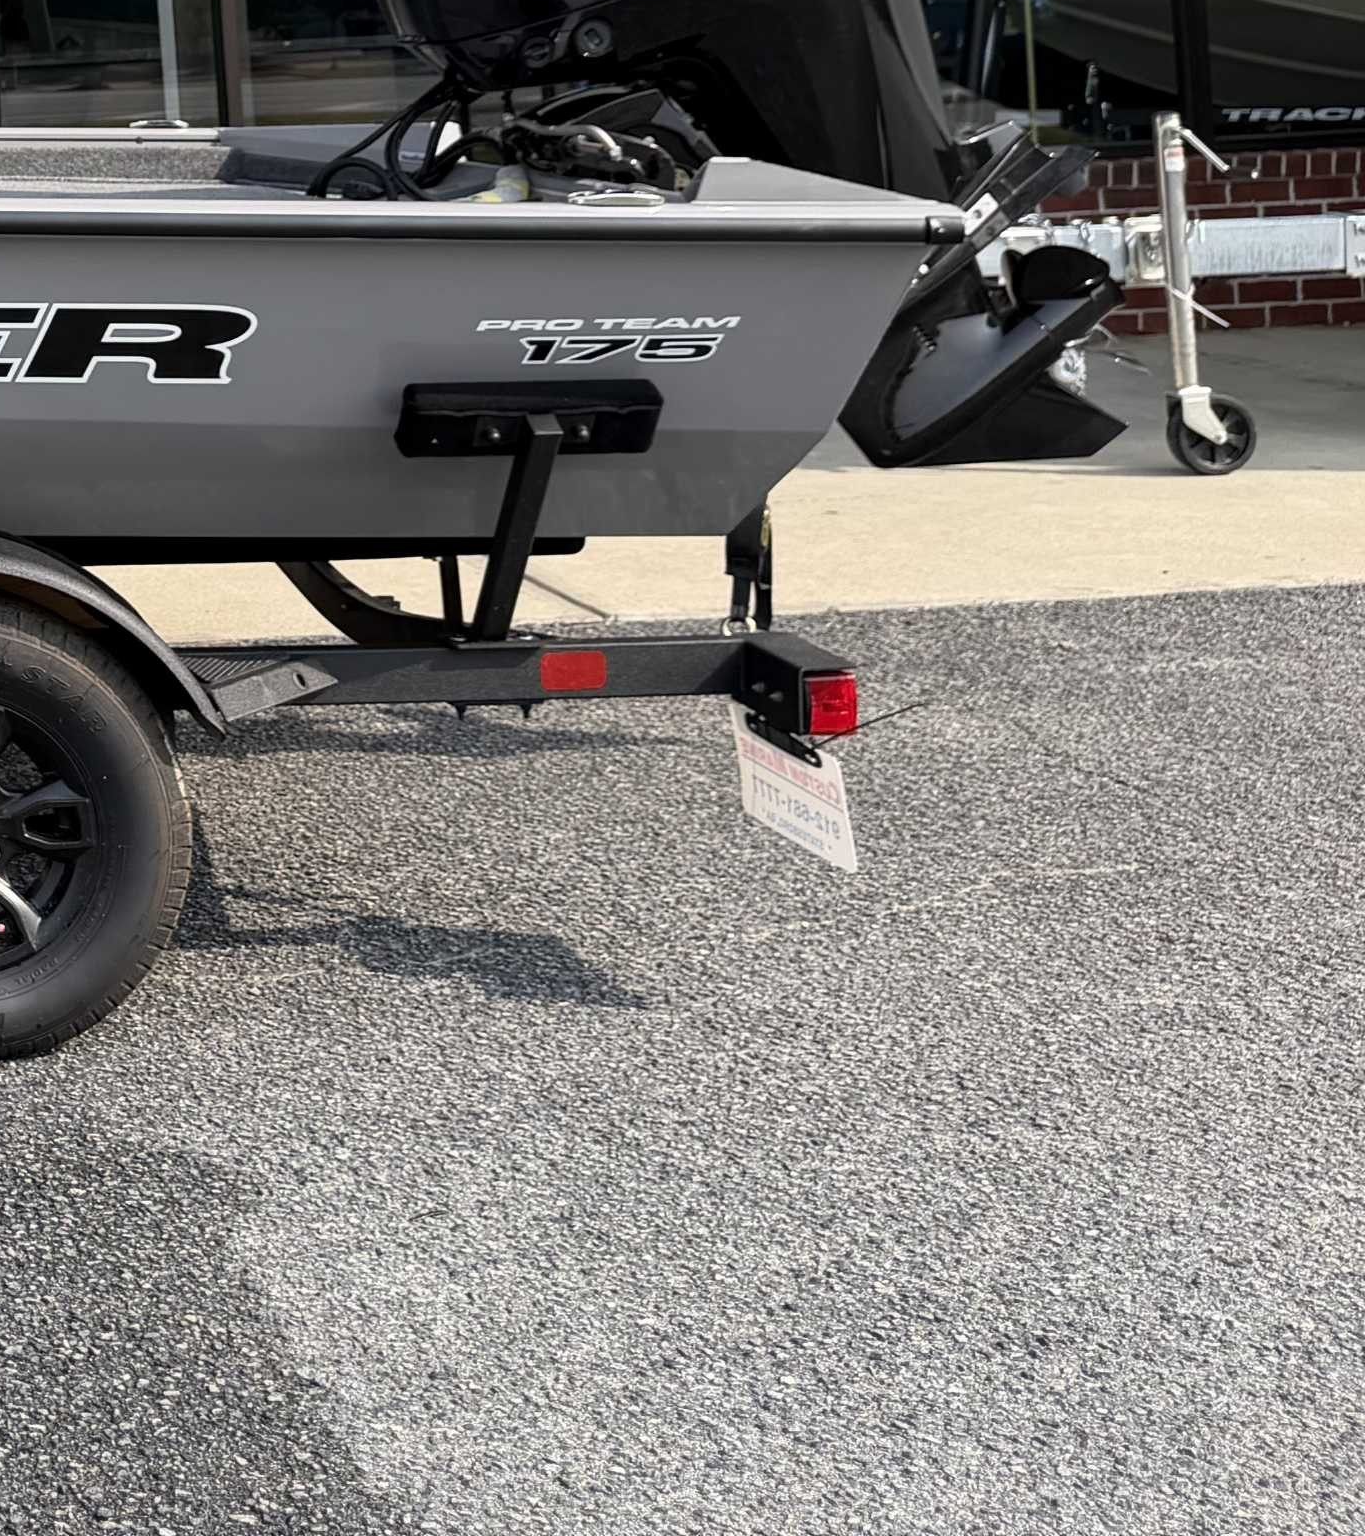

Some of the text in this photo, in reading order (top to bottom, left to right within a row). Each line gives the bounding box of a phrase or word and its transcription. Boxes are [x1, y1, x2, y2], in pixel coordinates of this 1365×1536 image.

[476, 316, 741, 332] PRO TEAM
[519, 333, 725, 365] 175
[20, 664, 108, 734] STAR
